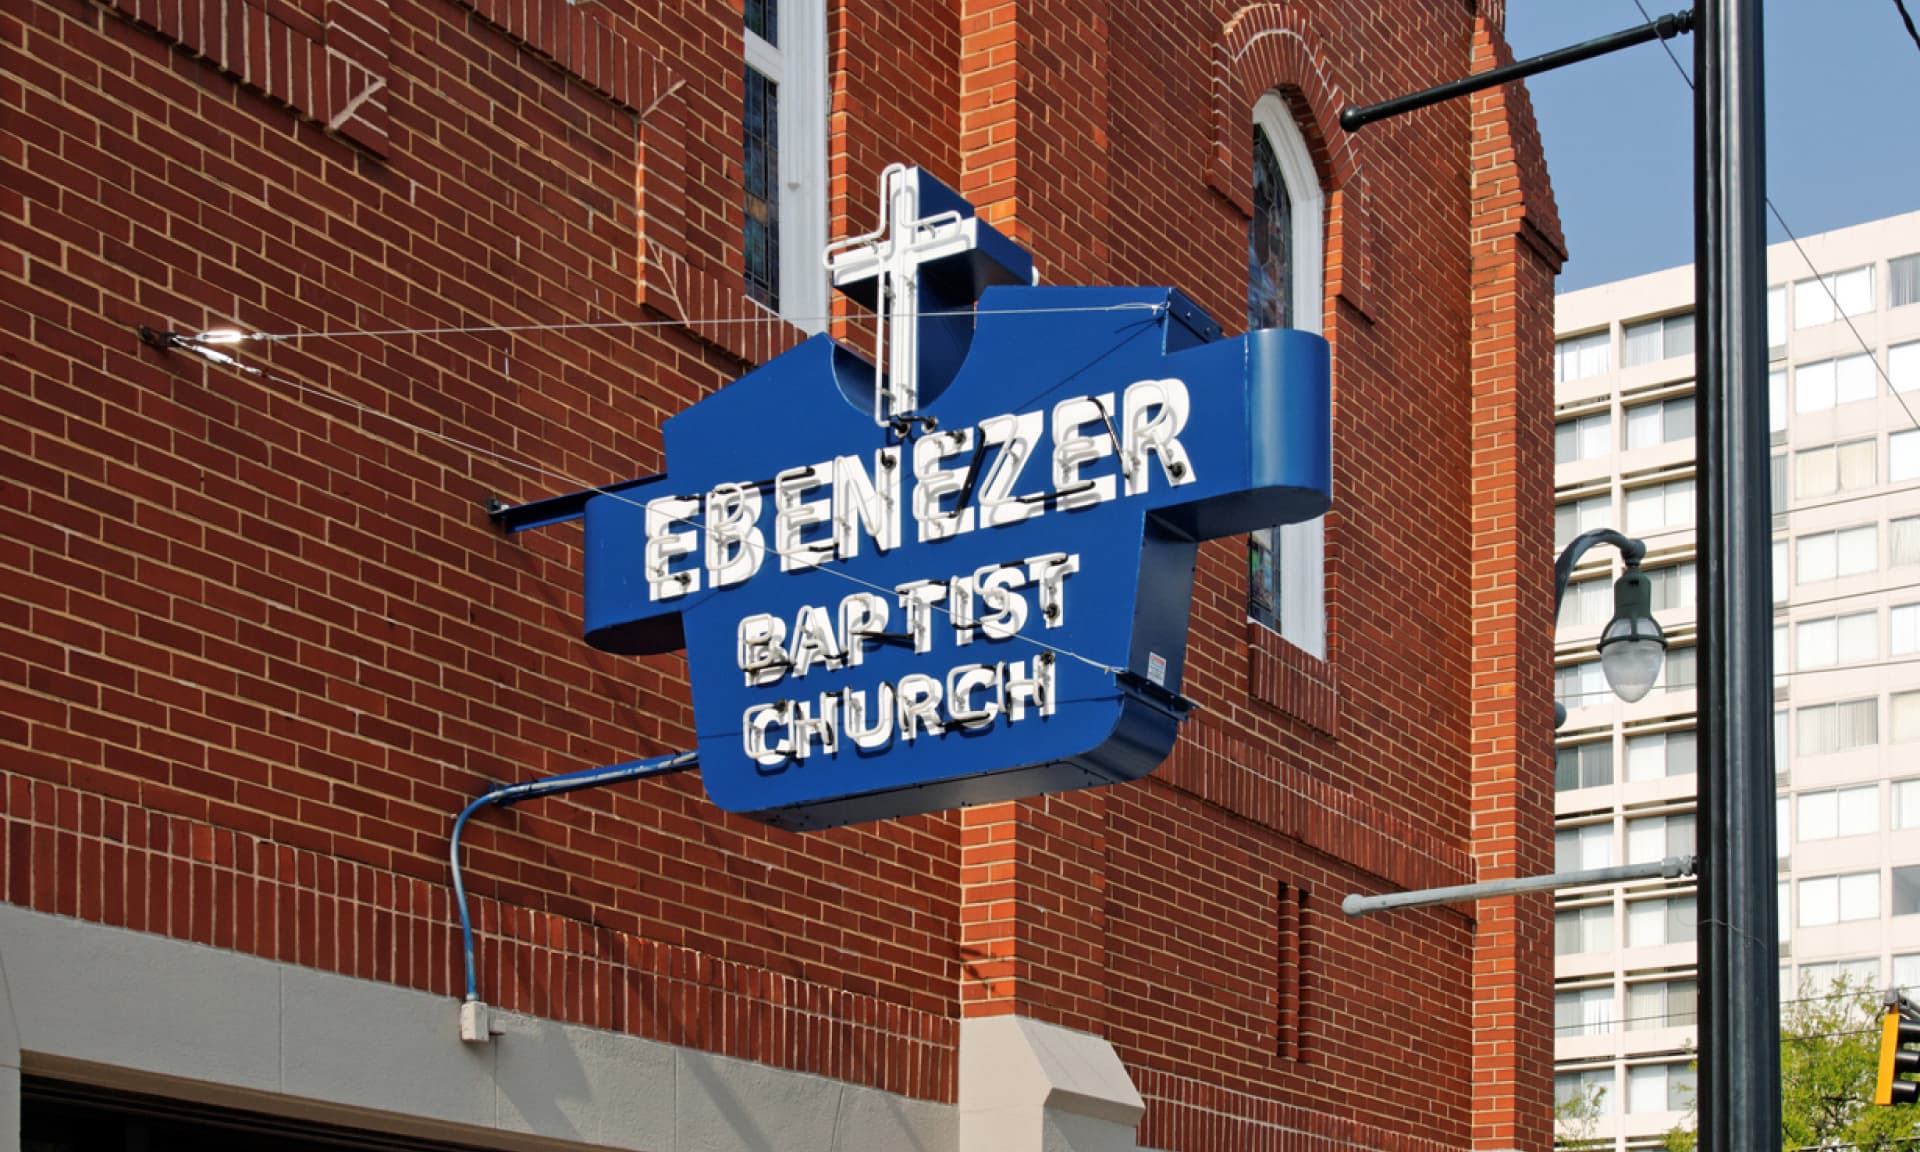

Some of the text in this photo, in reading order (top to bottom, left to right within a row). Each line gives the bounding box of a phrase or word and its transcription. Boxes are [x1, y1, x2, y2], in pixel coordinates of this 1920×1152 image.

[645, 378, 1196, 601] EBENEZER
[738, 553, 1079, 687] BAPTIST
[743, 653, 1056, 765] CHURCH
